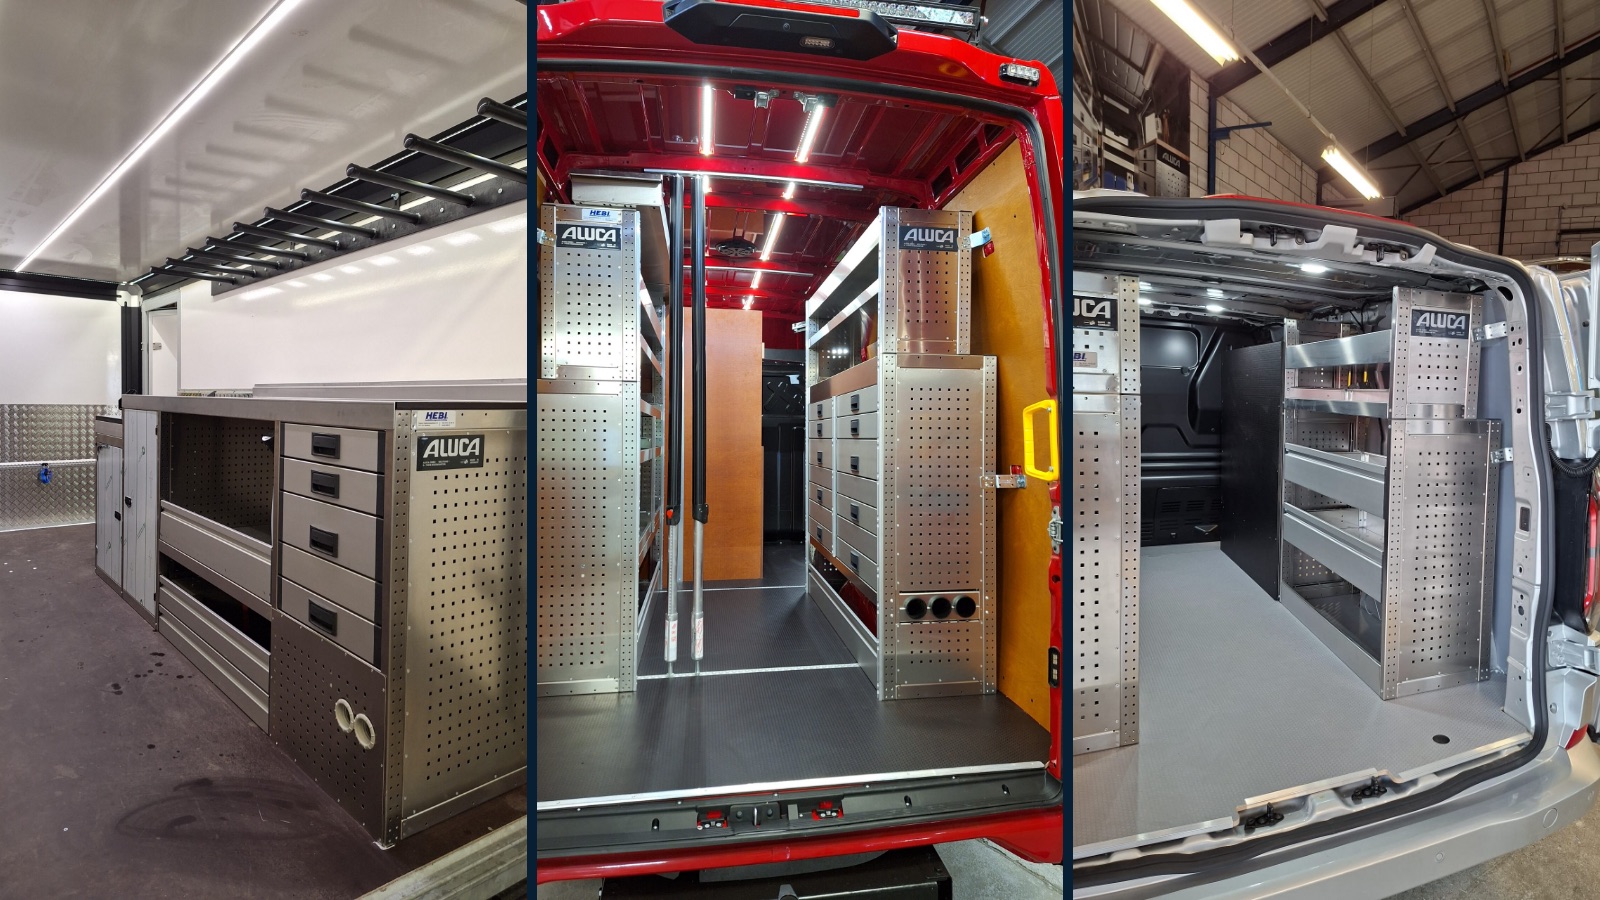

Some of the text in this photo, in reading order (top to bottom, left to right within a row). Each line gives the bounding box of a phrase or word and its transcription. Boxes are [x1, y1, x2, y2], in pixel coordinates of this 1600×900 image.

[561, 226, 616, 242] ALUCA
[903, 228, 953, 243] ALUCA
[1416, 312, 1466, 330] ALUCA
[425, 411, 448, 420] HEBI
[422, 437, 480, 458] ALUCA
